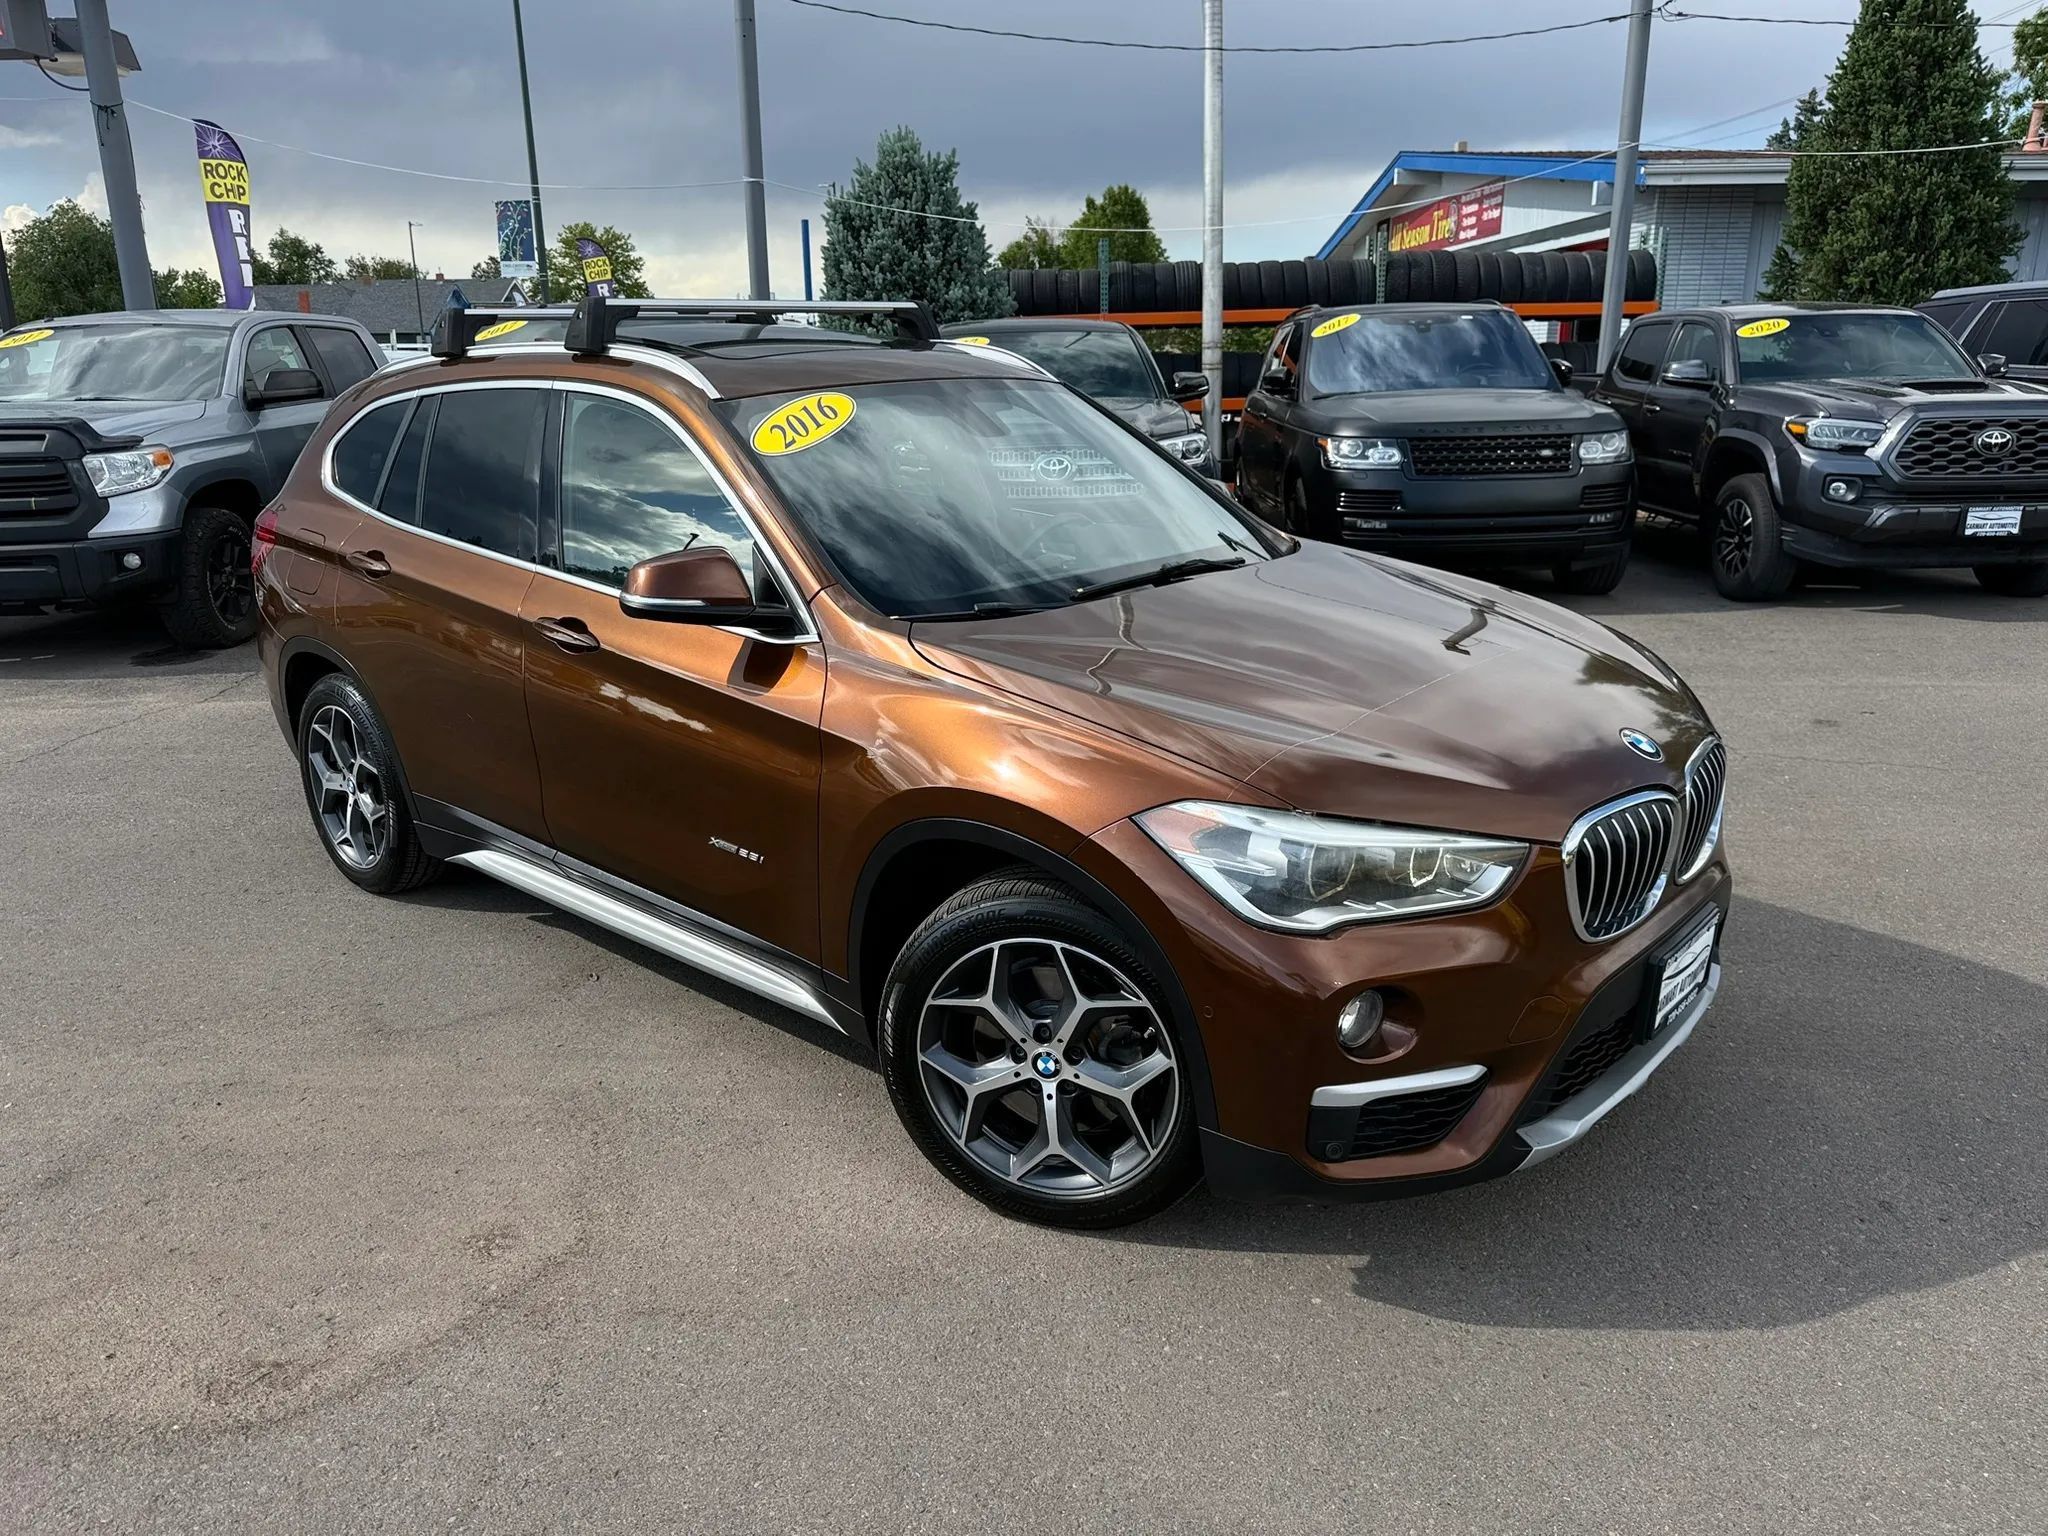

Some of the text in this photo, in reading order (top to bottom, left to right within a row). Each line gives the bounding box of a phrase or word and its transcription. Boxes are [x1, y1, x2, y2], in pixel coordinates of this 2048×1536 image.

[203, 162, 247, 183] ROCK
[210, 181, 246, 201] CHP
[584, 257, 609, 271] ROCK
[588, 269, 609, 281] CHIP
[1748, 320, 1780, 336] 2020
[769, 396, 839, 450] 2016
